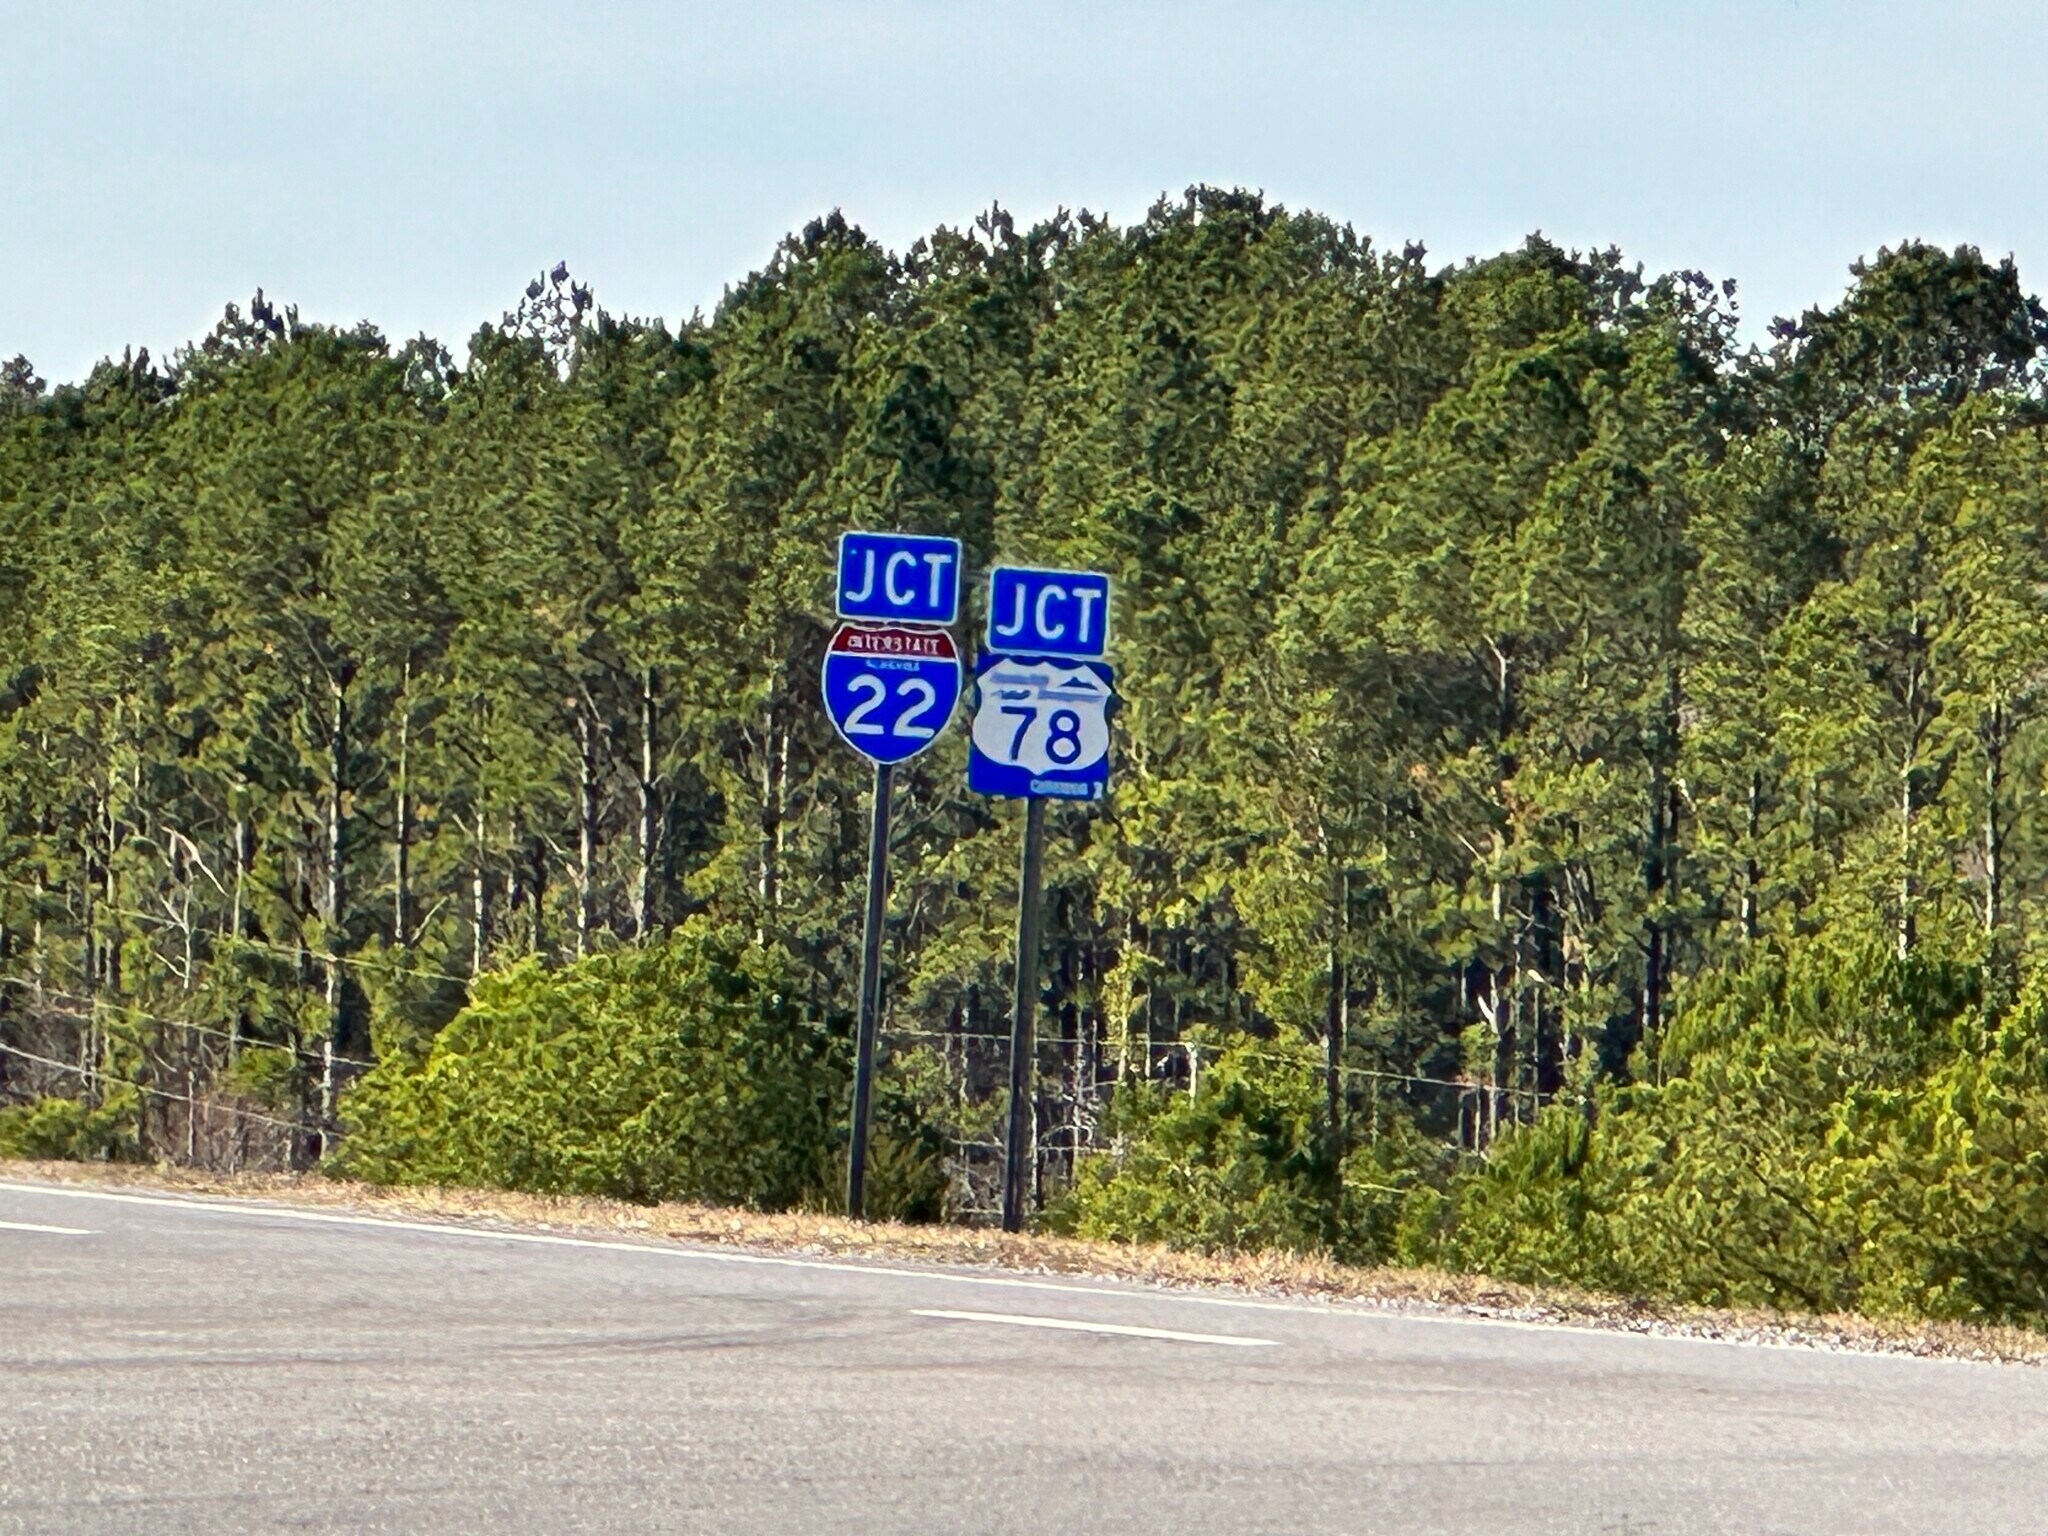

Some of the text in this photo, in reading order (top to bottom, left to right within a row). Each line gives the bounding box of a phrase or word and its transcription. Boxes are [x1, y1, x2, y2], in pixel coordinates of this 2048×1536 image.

[845, 549, 952, 607] JCT
[996, 583, 1101, 643] JCT
[843, 673, 936, 739] 22
[1000, 706, 1081, 765] 78
